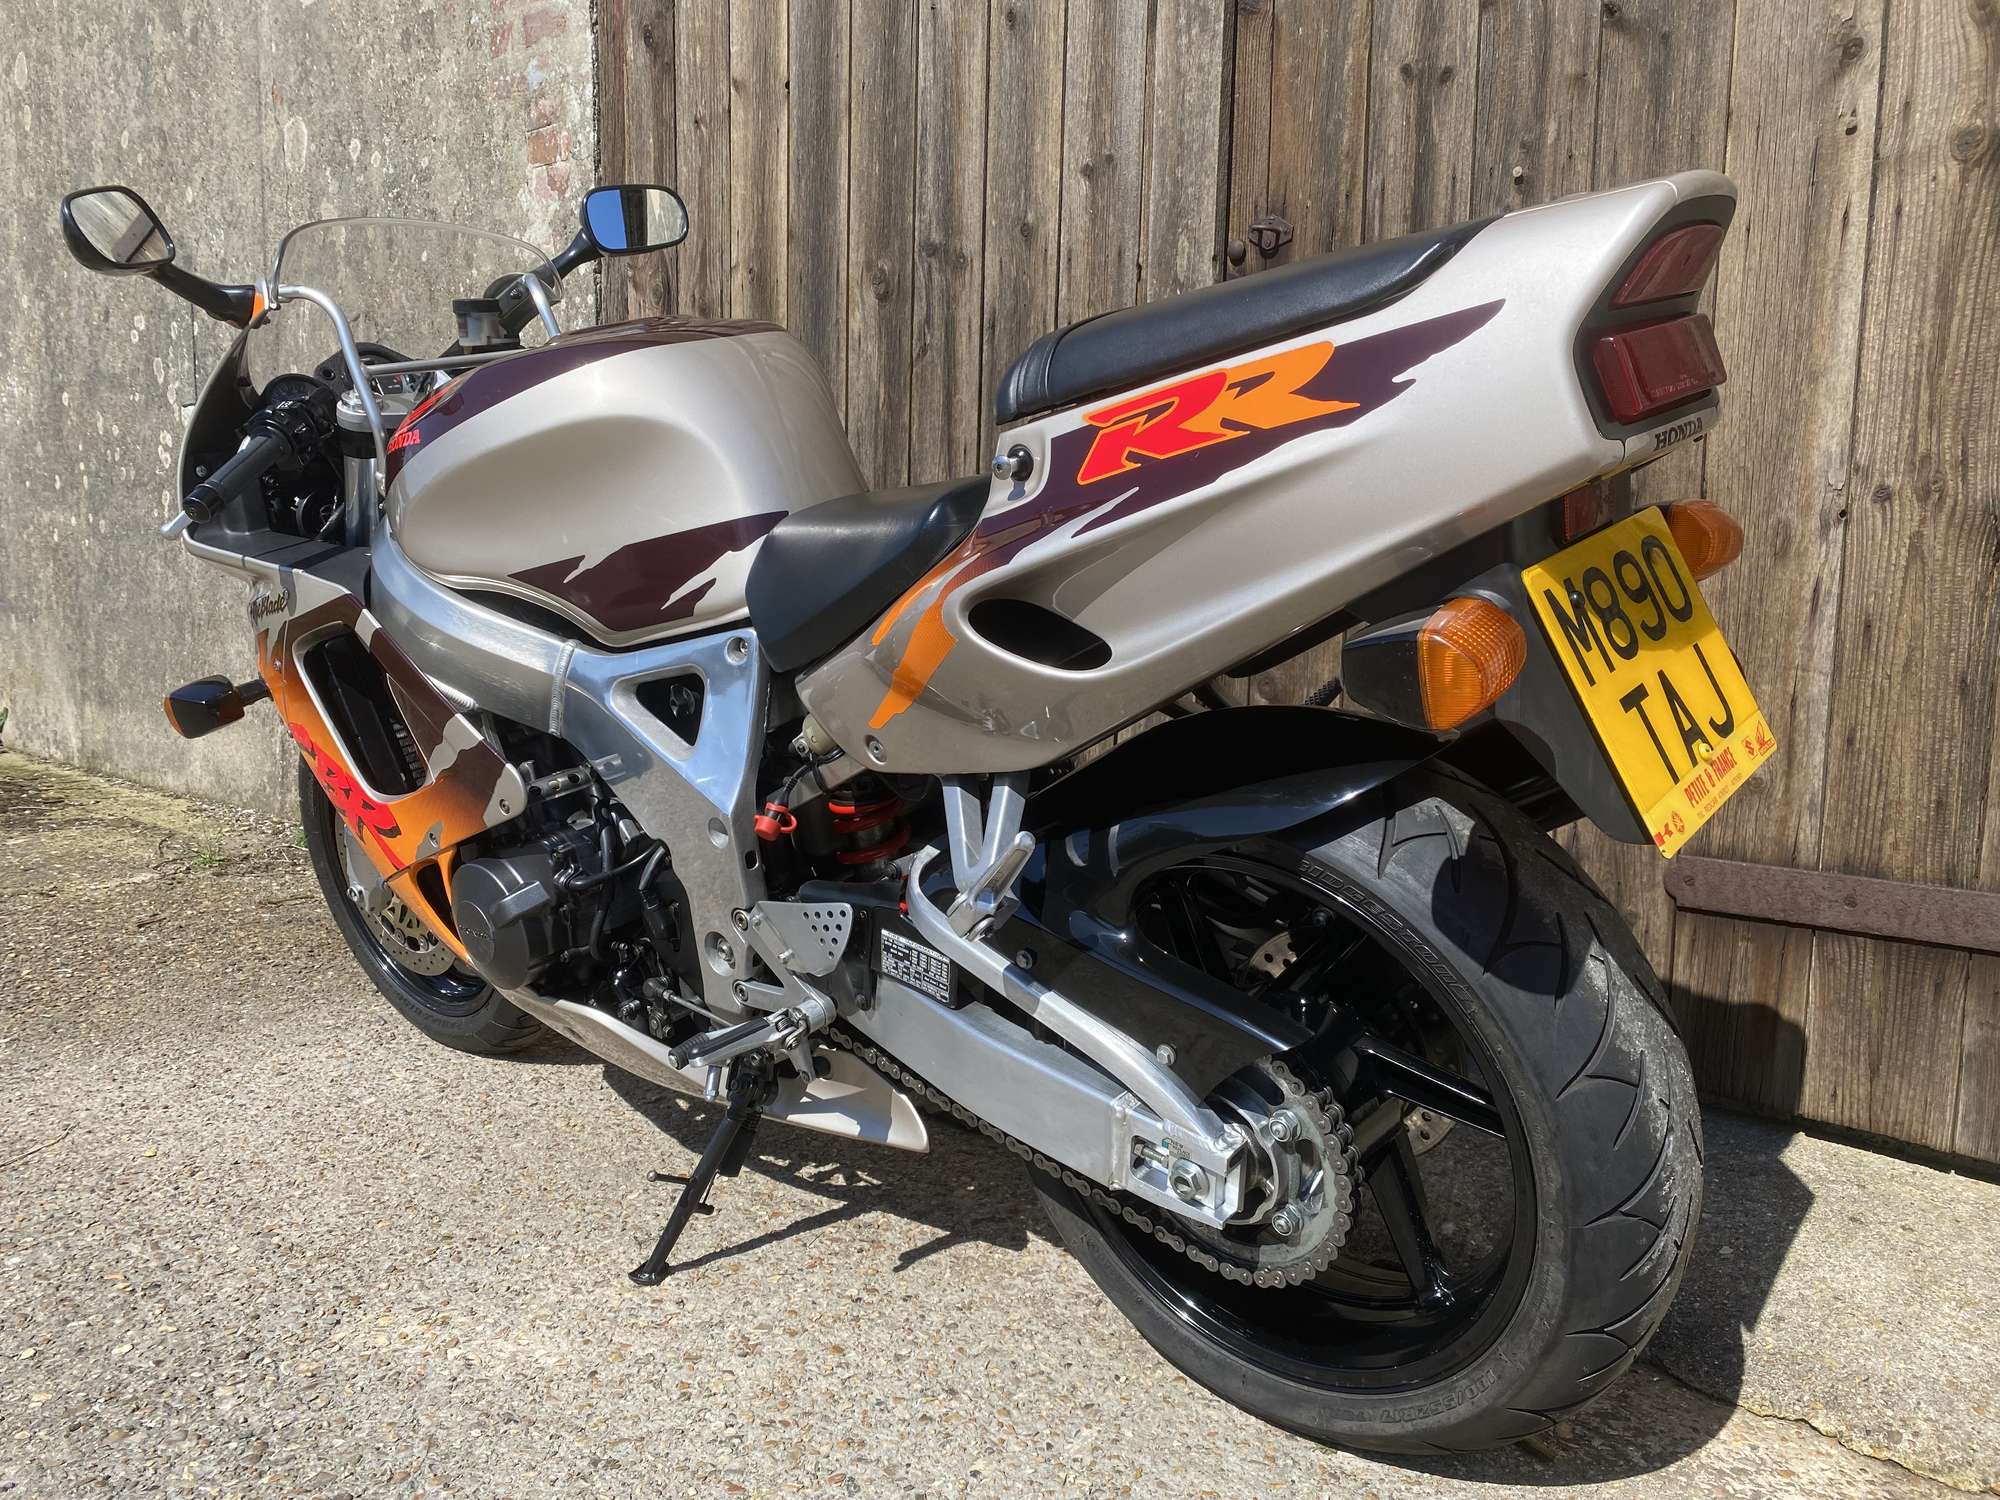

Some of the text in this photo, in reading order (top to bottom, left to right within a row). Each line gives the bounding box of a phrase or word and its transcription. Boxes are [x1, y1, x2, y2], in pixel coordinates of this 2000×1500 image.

[1077, 340, 1361, 486] RR
[1653, 417, 1703, 452] HONDA
[1543, 534, 1694, 688] M890
[1619, 642, 1735, 785] TAJ
[1683, 773, 1711, 809] PETITE
[1297, 858, 1479, 1004] RIDGESTONE
